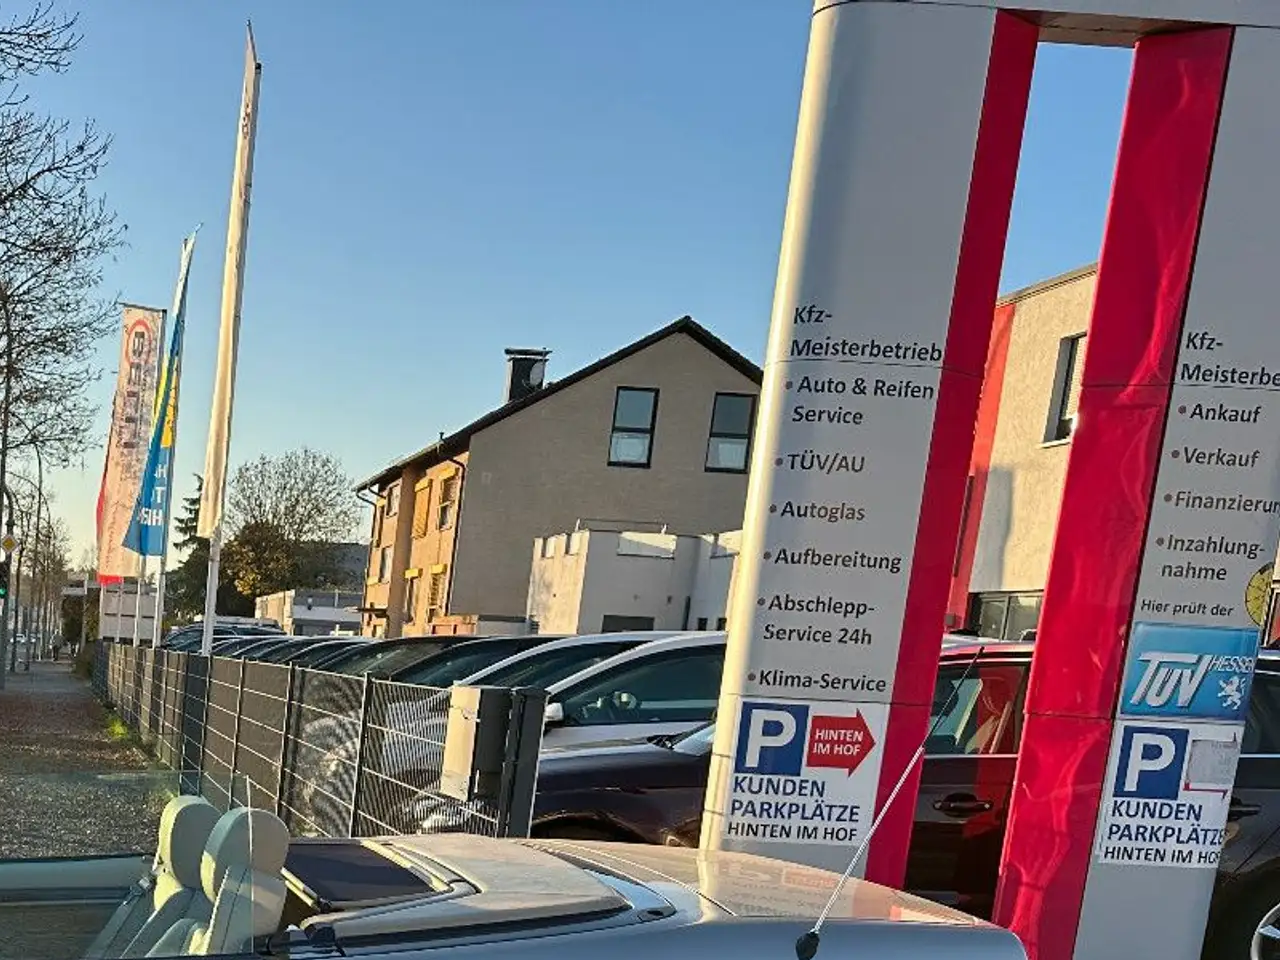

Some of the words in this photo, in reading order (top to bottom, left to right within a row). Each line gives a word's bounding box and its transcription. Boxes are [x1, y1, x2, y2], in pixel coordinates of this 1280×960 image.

[793, 305, 833, 325] Kfz-
[790, 337, 942, 362] Meisterbetrieb
[1185, 331, 1223, 351] Kfz-
[1180, 362, 1280, 387] Meisterbe
[797, 376, 846, 394] Auto
[852, 378, 868, 396] &
[873, 379, 934, 399] Reifen
[792, 405, 863, 425] Service
[1189, 403, 1262, 424] Ankauf
[787, 449, 866, 474] TÜV/AU
[1183, 447, 1261, 468] Verkauf
[780, 501, 866, 523] Autoglas
[1166, 534, 1266, 560] Inzahlung-
[774, 549, 902, 574] Aufbereitung
[1161, 562, 1228, 581] nahme
[768, 594, 875, 619] Abschlepp-
[1140, 599, 1170, 614] Hier
[1173, 601, 1207, 617] prüft
[1210, 603, 1234, 617] der
[763, 624, 832, 643] Service
[837, 627, 872, 645] 24h
[759, 669, 887, 692] Klima-Service
[745, 709, 797, 768] P
[815, 728, 863, 742] HINTEN
[813, 743, 831, 755] IM
[833, 744, 861, 756] HOF
[1123, 733, 1176, 792] P
[732, 776, 826, 798] KUNDEN
[730, 796, 861, 823] PARKPLÄTZE
[1111, 800, 1203, 822] KUNDEN
[727, 822, 792, 839] HINTEN
[796, 825, 818, 840] IM
[823, 826, 858, 842] HOF
[1104, 845, 1166, 862] HINTEN
[1171, 849, 1193, 863] IM
[1197, 850, 1221, 864] HO
